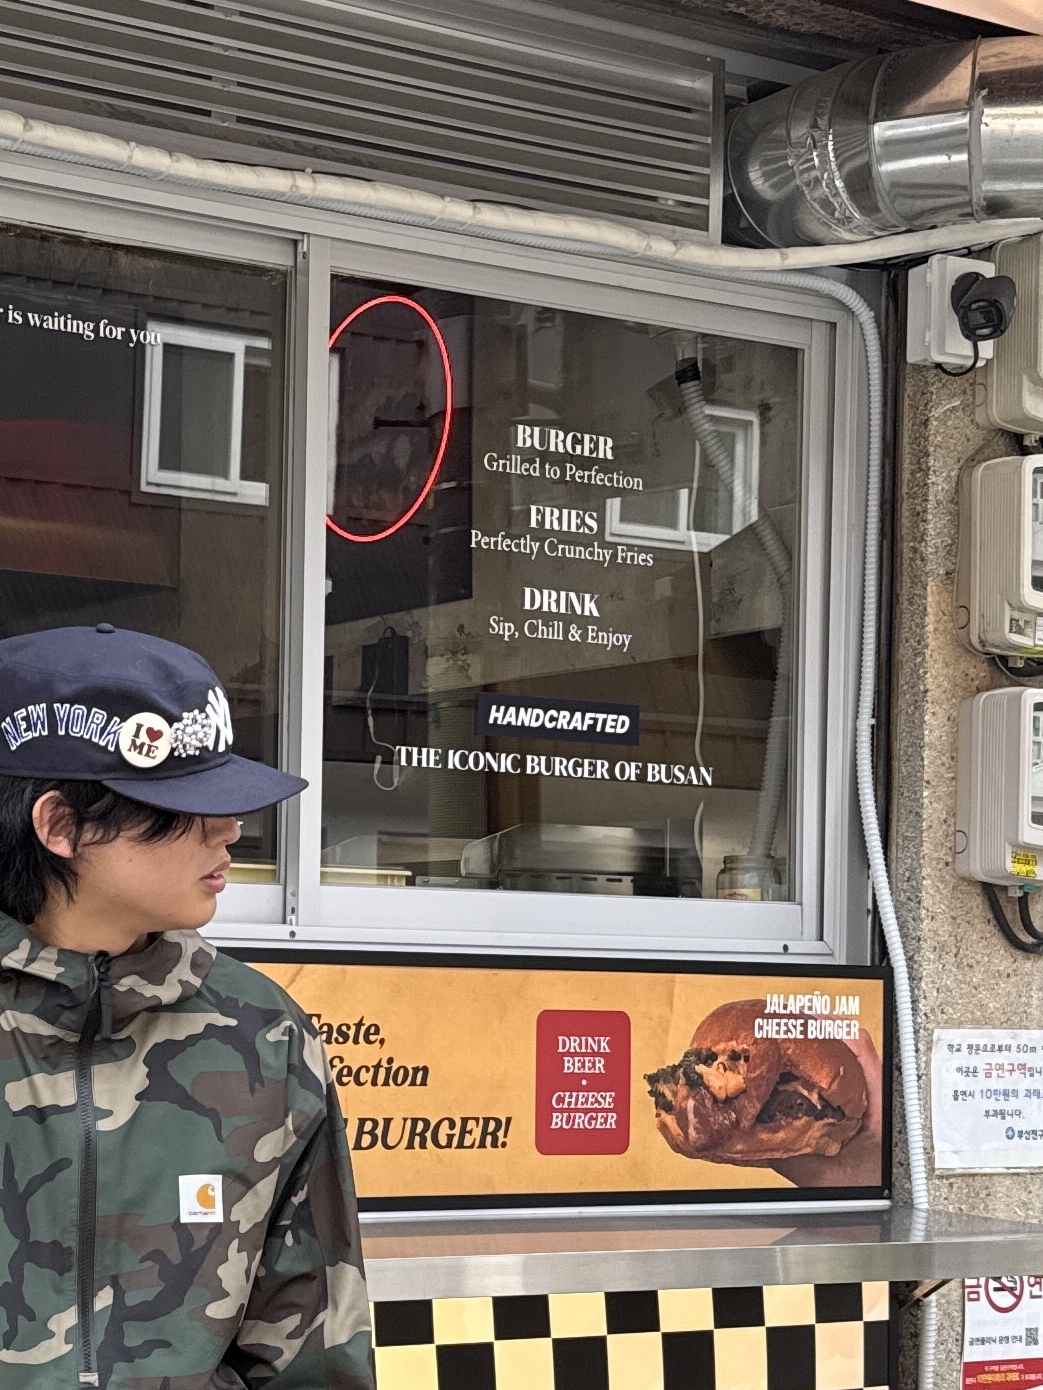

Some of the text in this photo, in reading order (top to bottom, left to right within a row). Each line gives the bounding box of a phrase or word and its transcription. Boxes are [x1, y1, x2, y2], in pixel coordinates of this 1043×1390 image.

[8, 304, 23, 325] is
[28, 308, 95, 341] waiting
[99, 319, 126, 342] for
[129, 328, 162, 348] you
[515, 423, 615, 460] BURGER
[483, 452, 644, 491] Grilled to Perfection
[528, 504, 599, 534] FRIES
[470, 529, 654, 568] Perfectly Crunchy Fries
[523, 586, 600, 617] DRINK
[488, 615, 633, 652] Sip, Chill & Enjoy
[1, 702, 49, 751] NEW
[132, 722, 145, 740] I
[488, 704, 631, 734] HANDCRAFTED
[127, 739, 159, 760] ME
[395, 744, 714, 786] THE ICONIC BURGER OF BUSAN
[764, 990, 860, 1016] JALAPEÑO JAM
[557, 1035, 611, 1053] DRINK
[754, 1018, 860, 1040] CHEESE BURGER
[1016, 1043, 1037, 1054] 50m
[328, 1055, 430, 1087] fection
[562, 1056, 606, 1073] BEER
[983, 1062, 1043, 1079] 금연구역입니
[551, 1091, 616, 1109] CHEESE
[1023, 1088, 1043, 1100] 과태
[351, 1116, 513, 1151] BURGER!
[550, 1112, 617, 1129] BURGER
